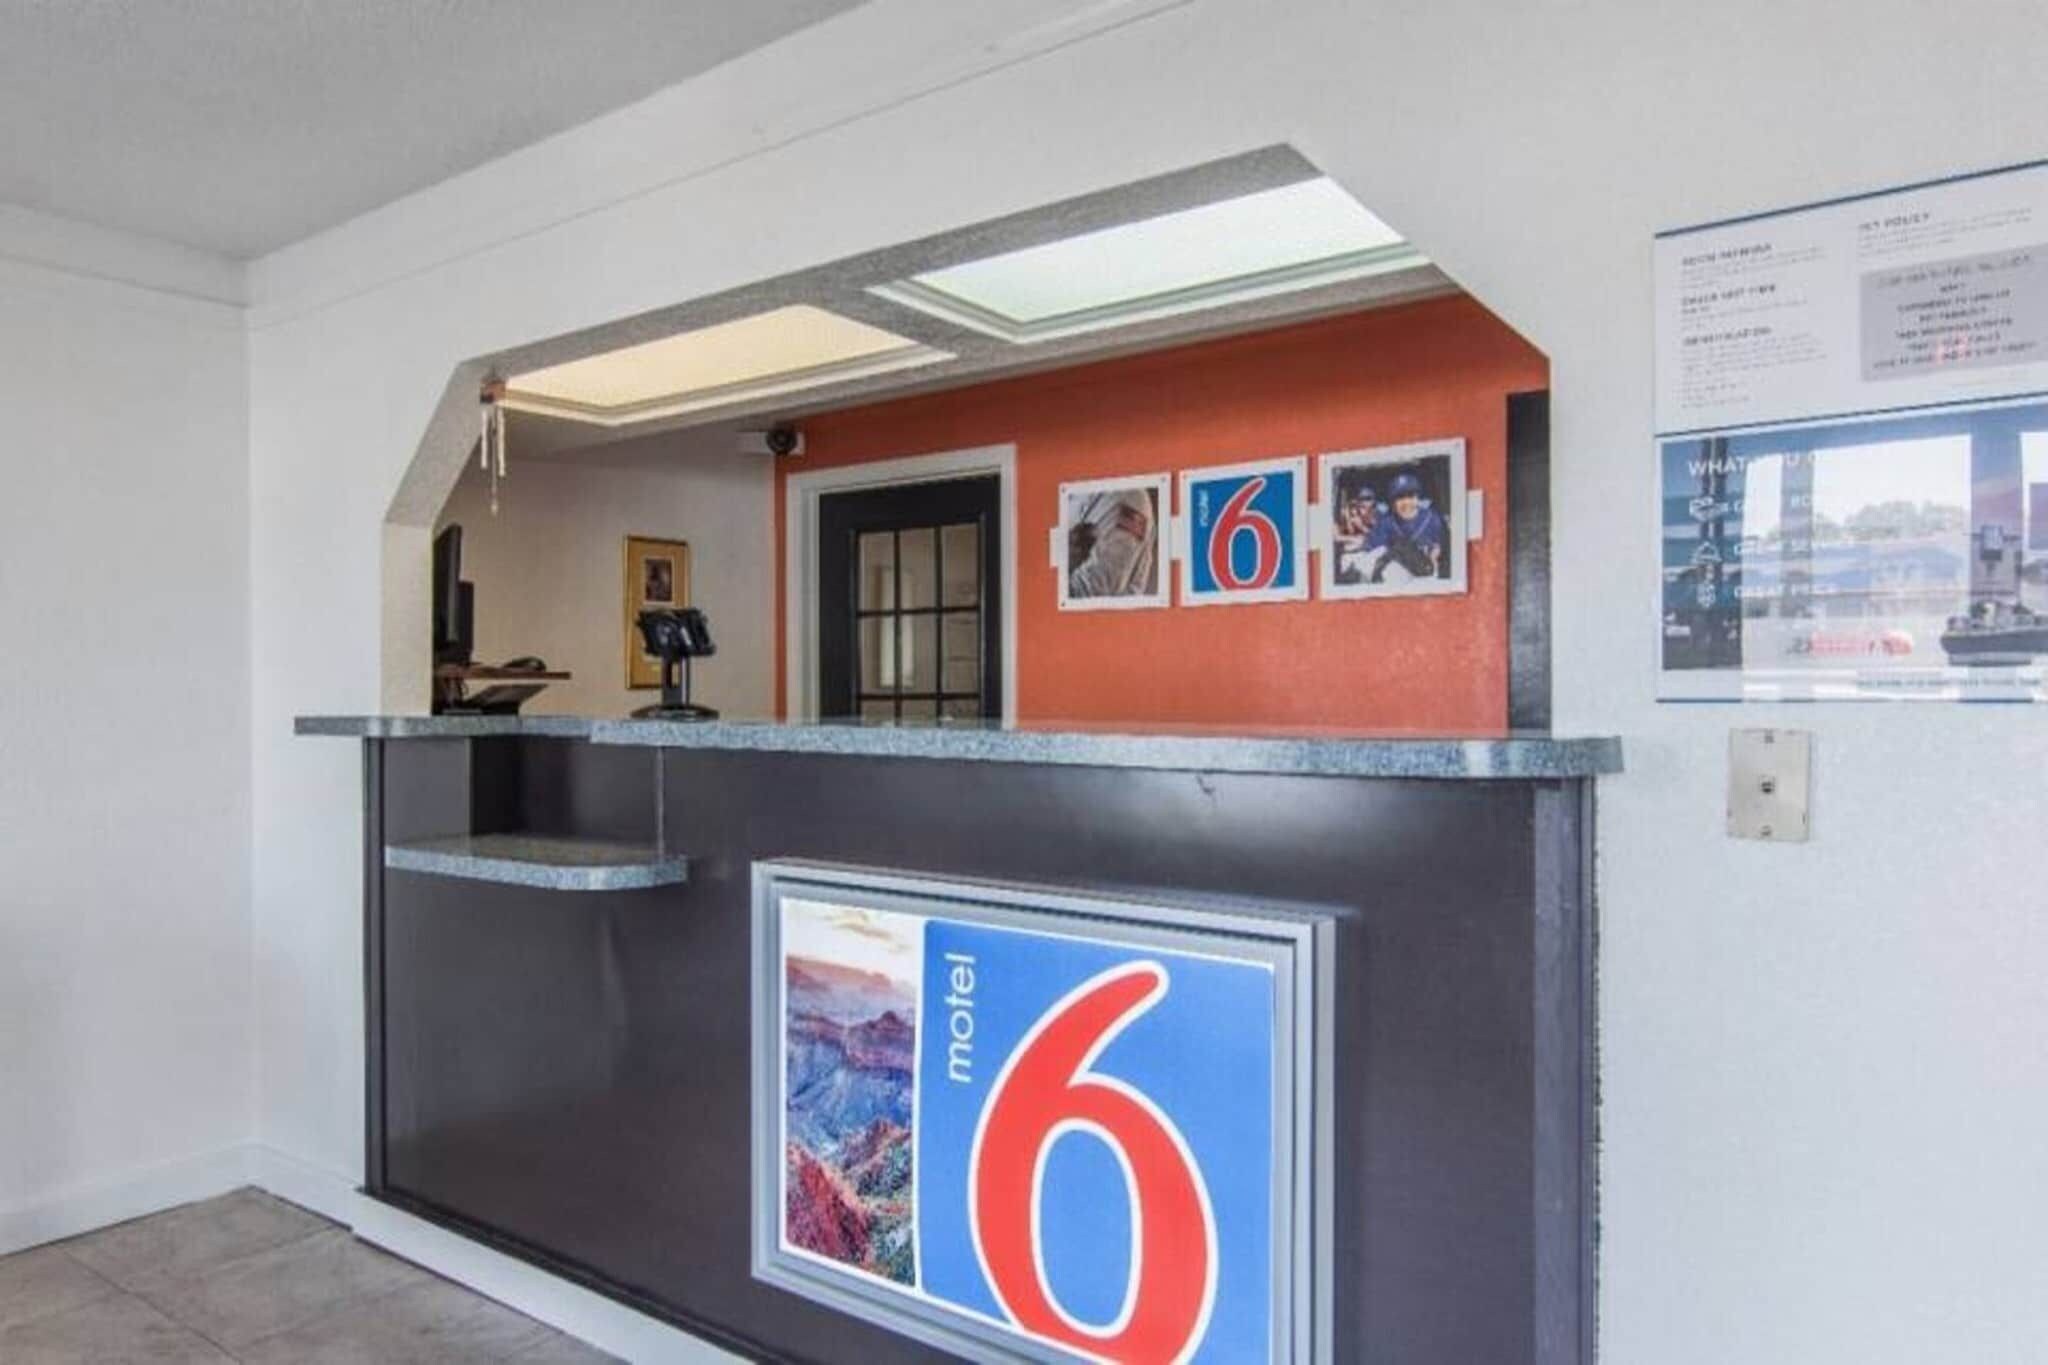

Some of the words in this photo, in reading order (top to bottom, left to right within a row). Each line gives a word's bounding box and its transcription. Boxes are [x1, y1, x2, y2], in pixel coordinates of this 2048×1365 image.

[1688, 455, 1746, 476] WHAT
[1208, 476, 1282, 590] 6
[944, 952, 976, 1082] motel
[967, 959, 1218, 1365] 6
